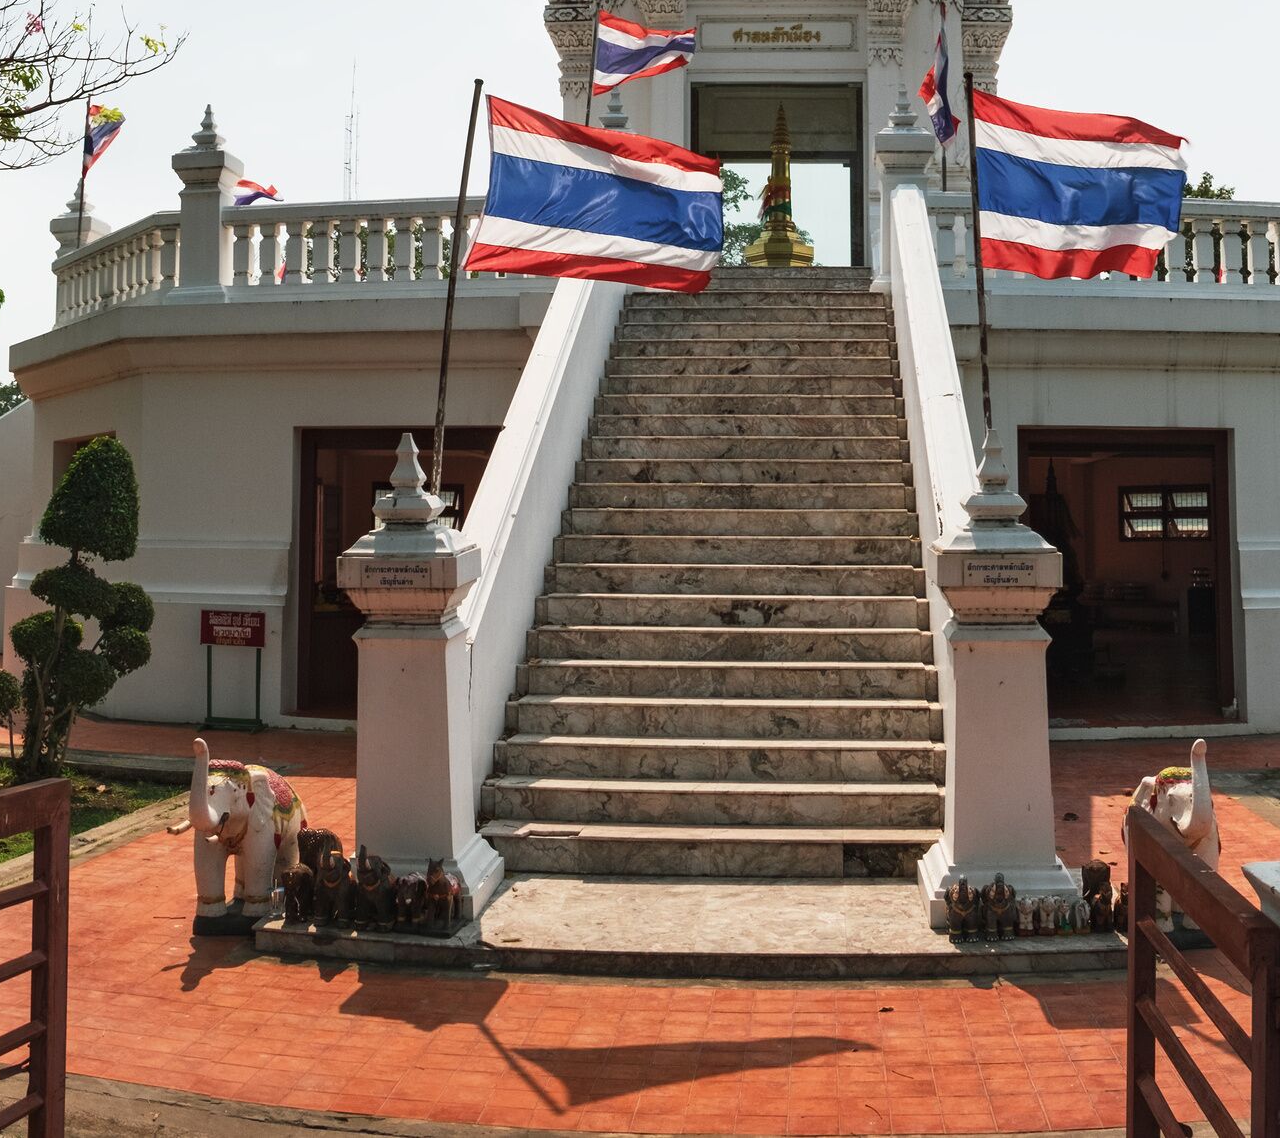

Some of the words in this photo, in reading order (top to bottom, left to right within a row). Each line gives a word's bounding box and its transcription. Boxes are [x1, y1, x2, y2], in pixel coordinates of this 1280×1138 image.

[732, 23, 822, 44] ศาลหลักเมือง
